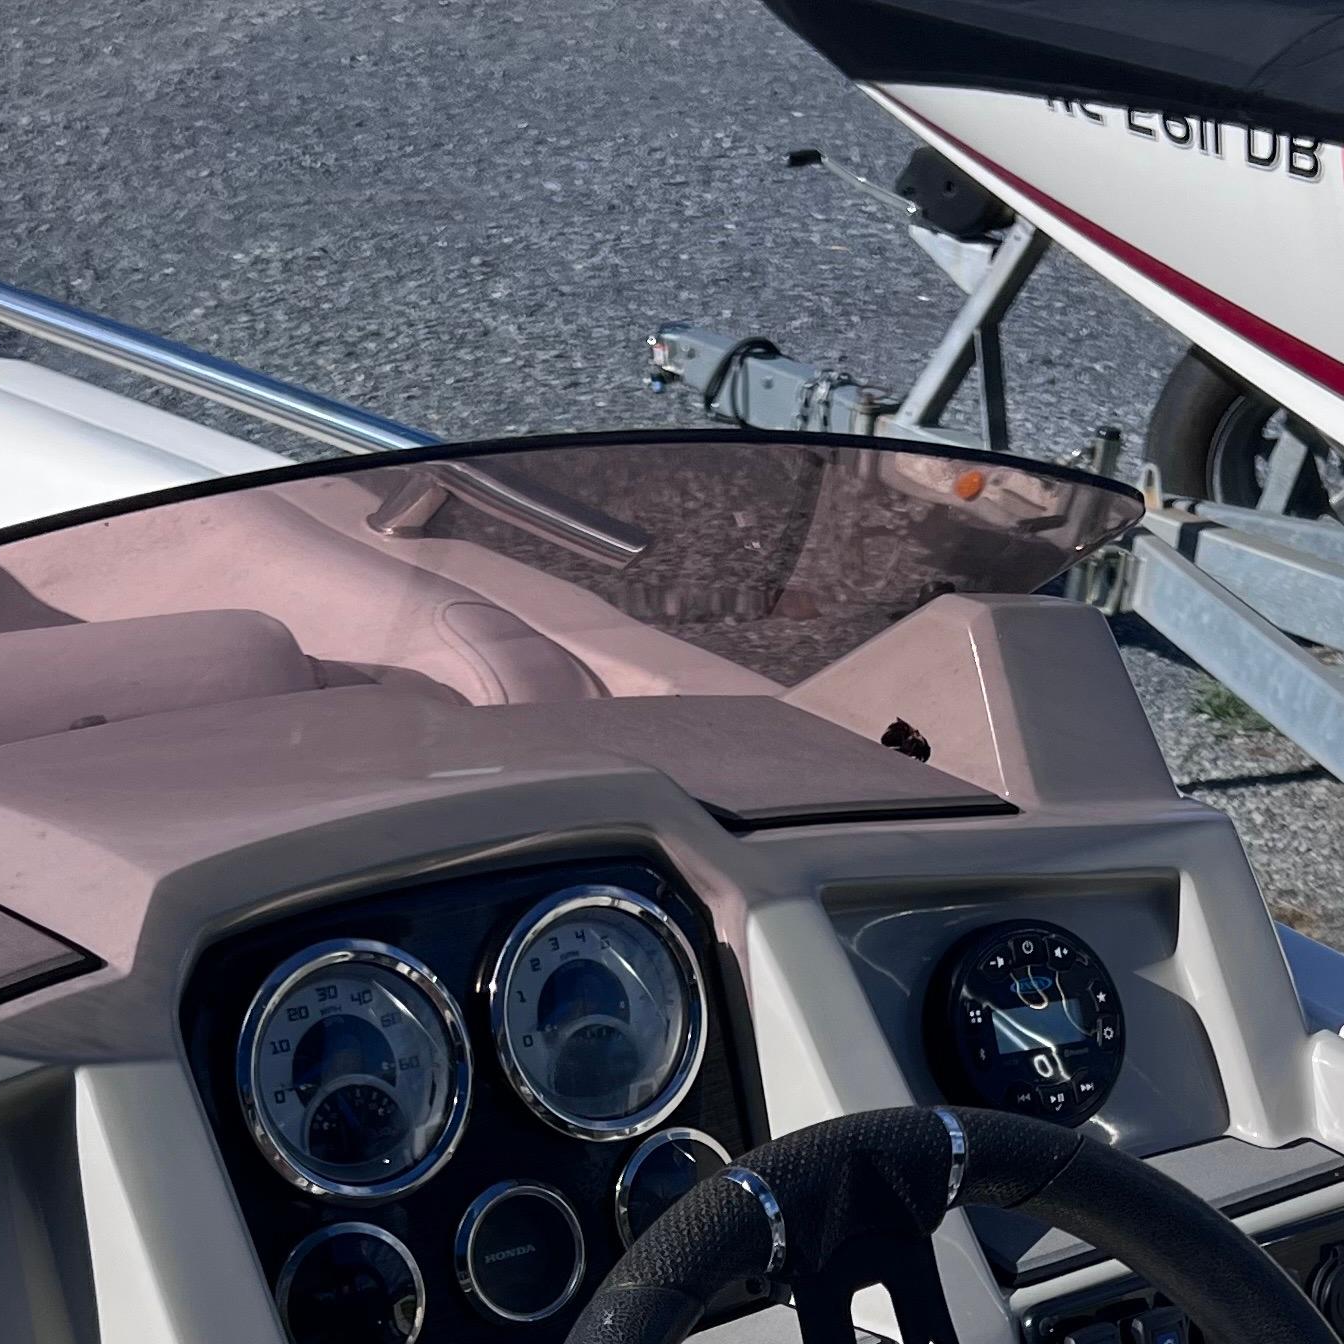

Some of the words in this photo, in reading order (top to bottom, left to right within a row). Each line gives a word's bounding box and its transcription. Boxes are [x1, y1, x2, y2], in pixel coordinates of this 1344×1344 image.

[1247, 128, 1320, 178] DB
[549, 937, 560, 951] 3
[315, 984, 338, 1001] 30
[350, 989, 374, 1006] 40
[287, 1005, 309, 1022] 20
[270, 1039, 291, 1055] 10
[484, 1244, 536, 1263] HONDA
